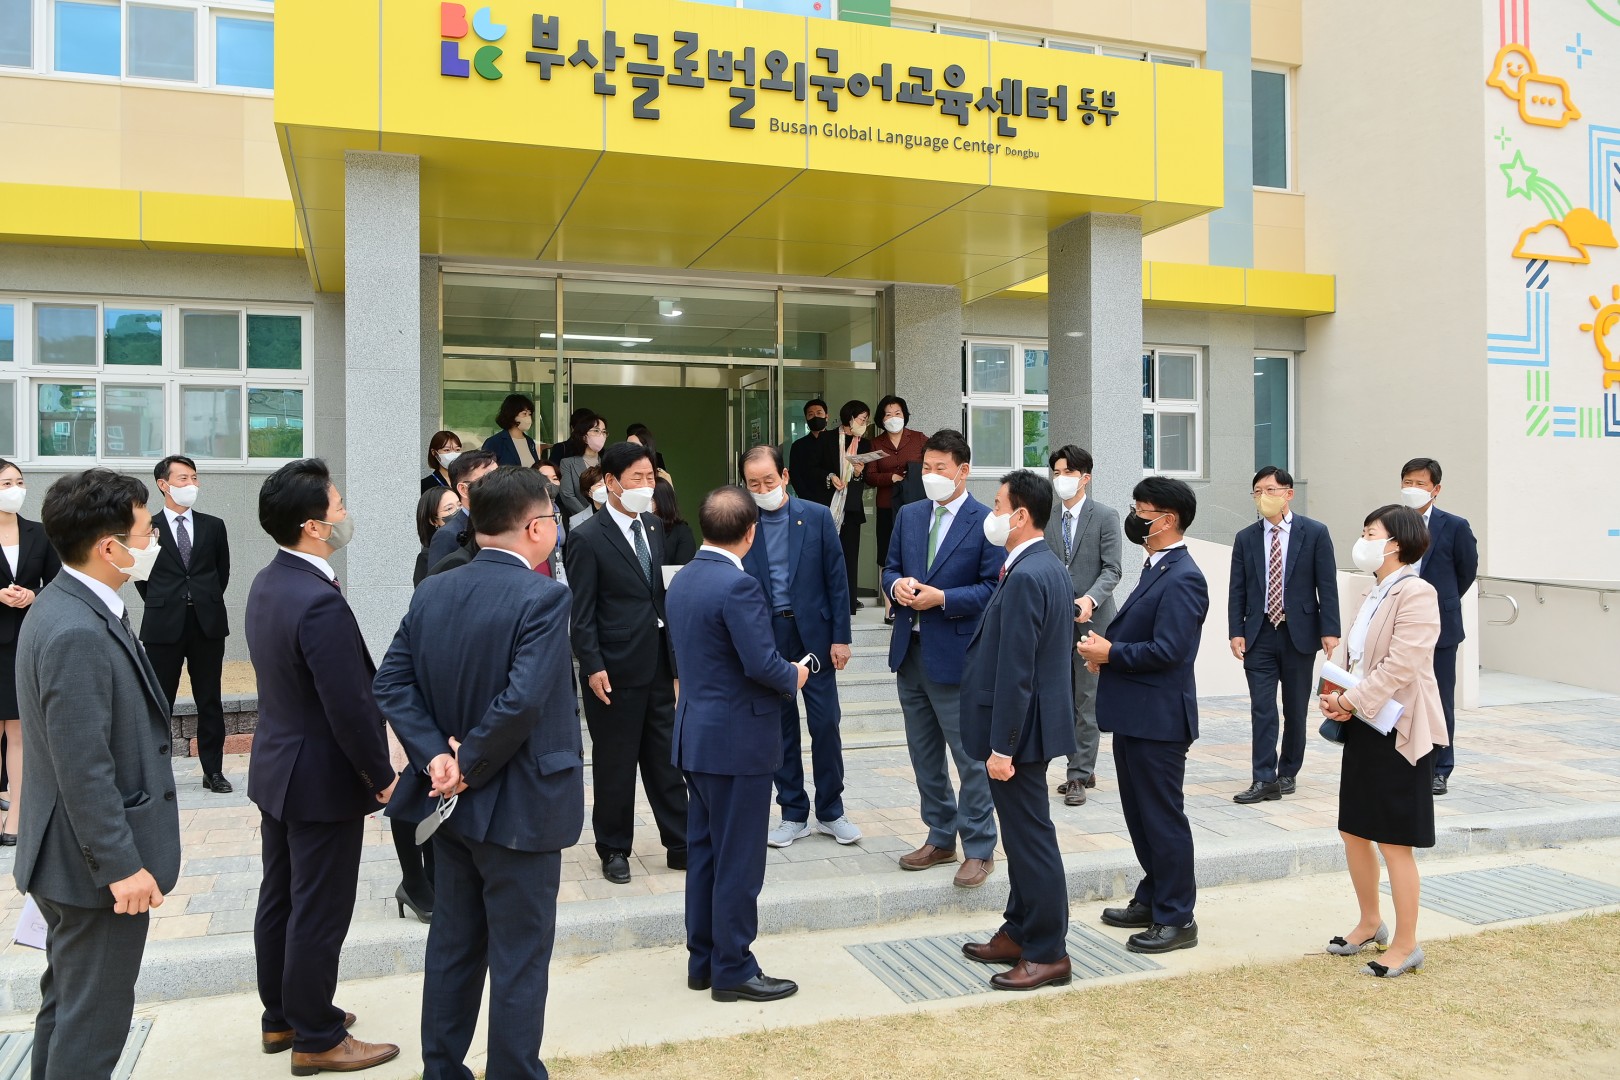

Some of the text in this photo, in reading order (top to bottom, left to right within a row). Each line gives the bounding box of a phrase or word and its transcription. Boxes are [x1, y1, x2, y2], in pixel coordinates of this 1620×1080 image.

[525, 13, 1120, 137] 부산글로벌외국어교육센터 동부
[769, 117, 1040, 158] Busan Global Language Center Dongbu
